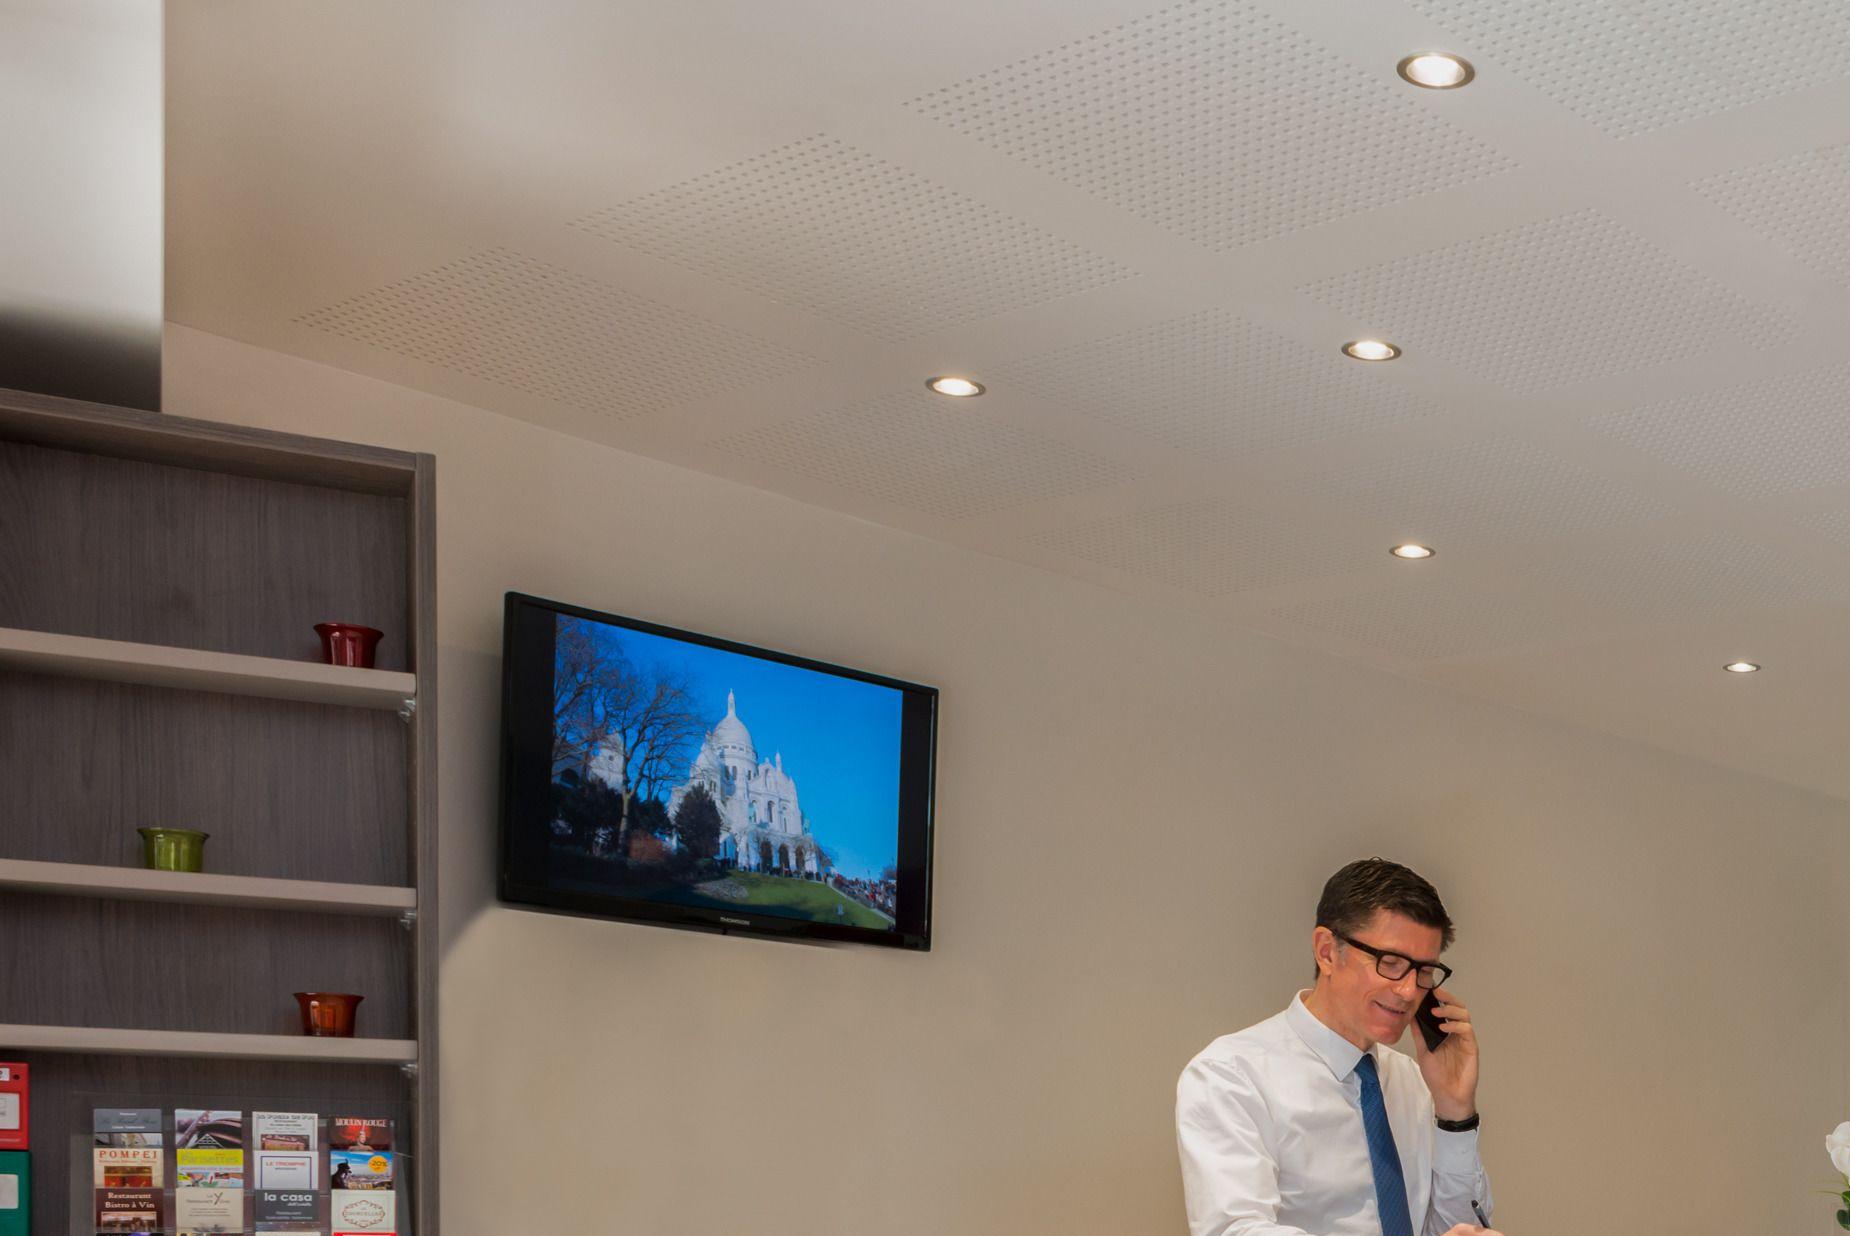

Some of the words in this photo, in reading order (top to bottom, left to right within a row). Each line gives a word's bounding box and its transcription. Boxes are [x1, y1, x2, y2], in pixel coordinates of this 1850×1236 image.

[335, 1118, 362, 1127] MOULIN
[363, 1119, 388, 1128] ROUGE
[264, 1192, 277, 1202] la
[280, 1194, 313, 1202] casa
[105, 1201, 130, 1209] Bistro
[138, 1201, 155, 1209] Vin
